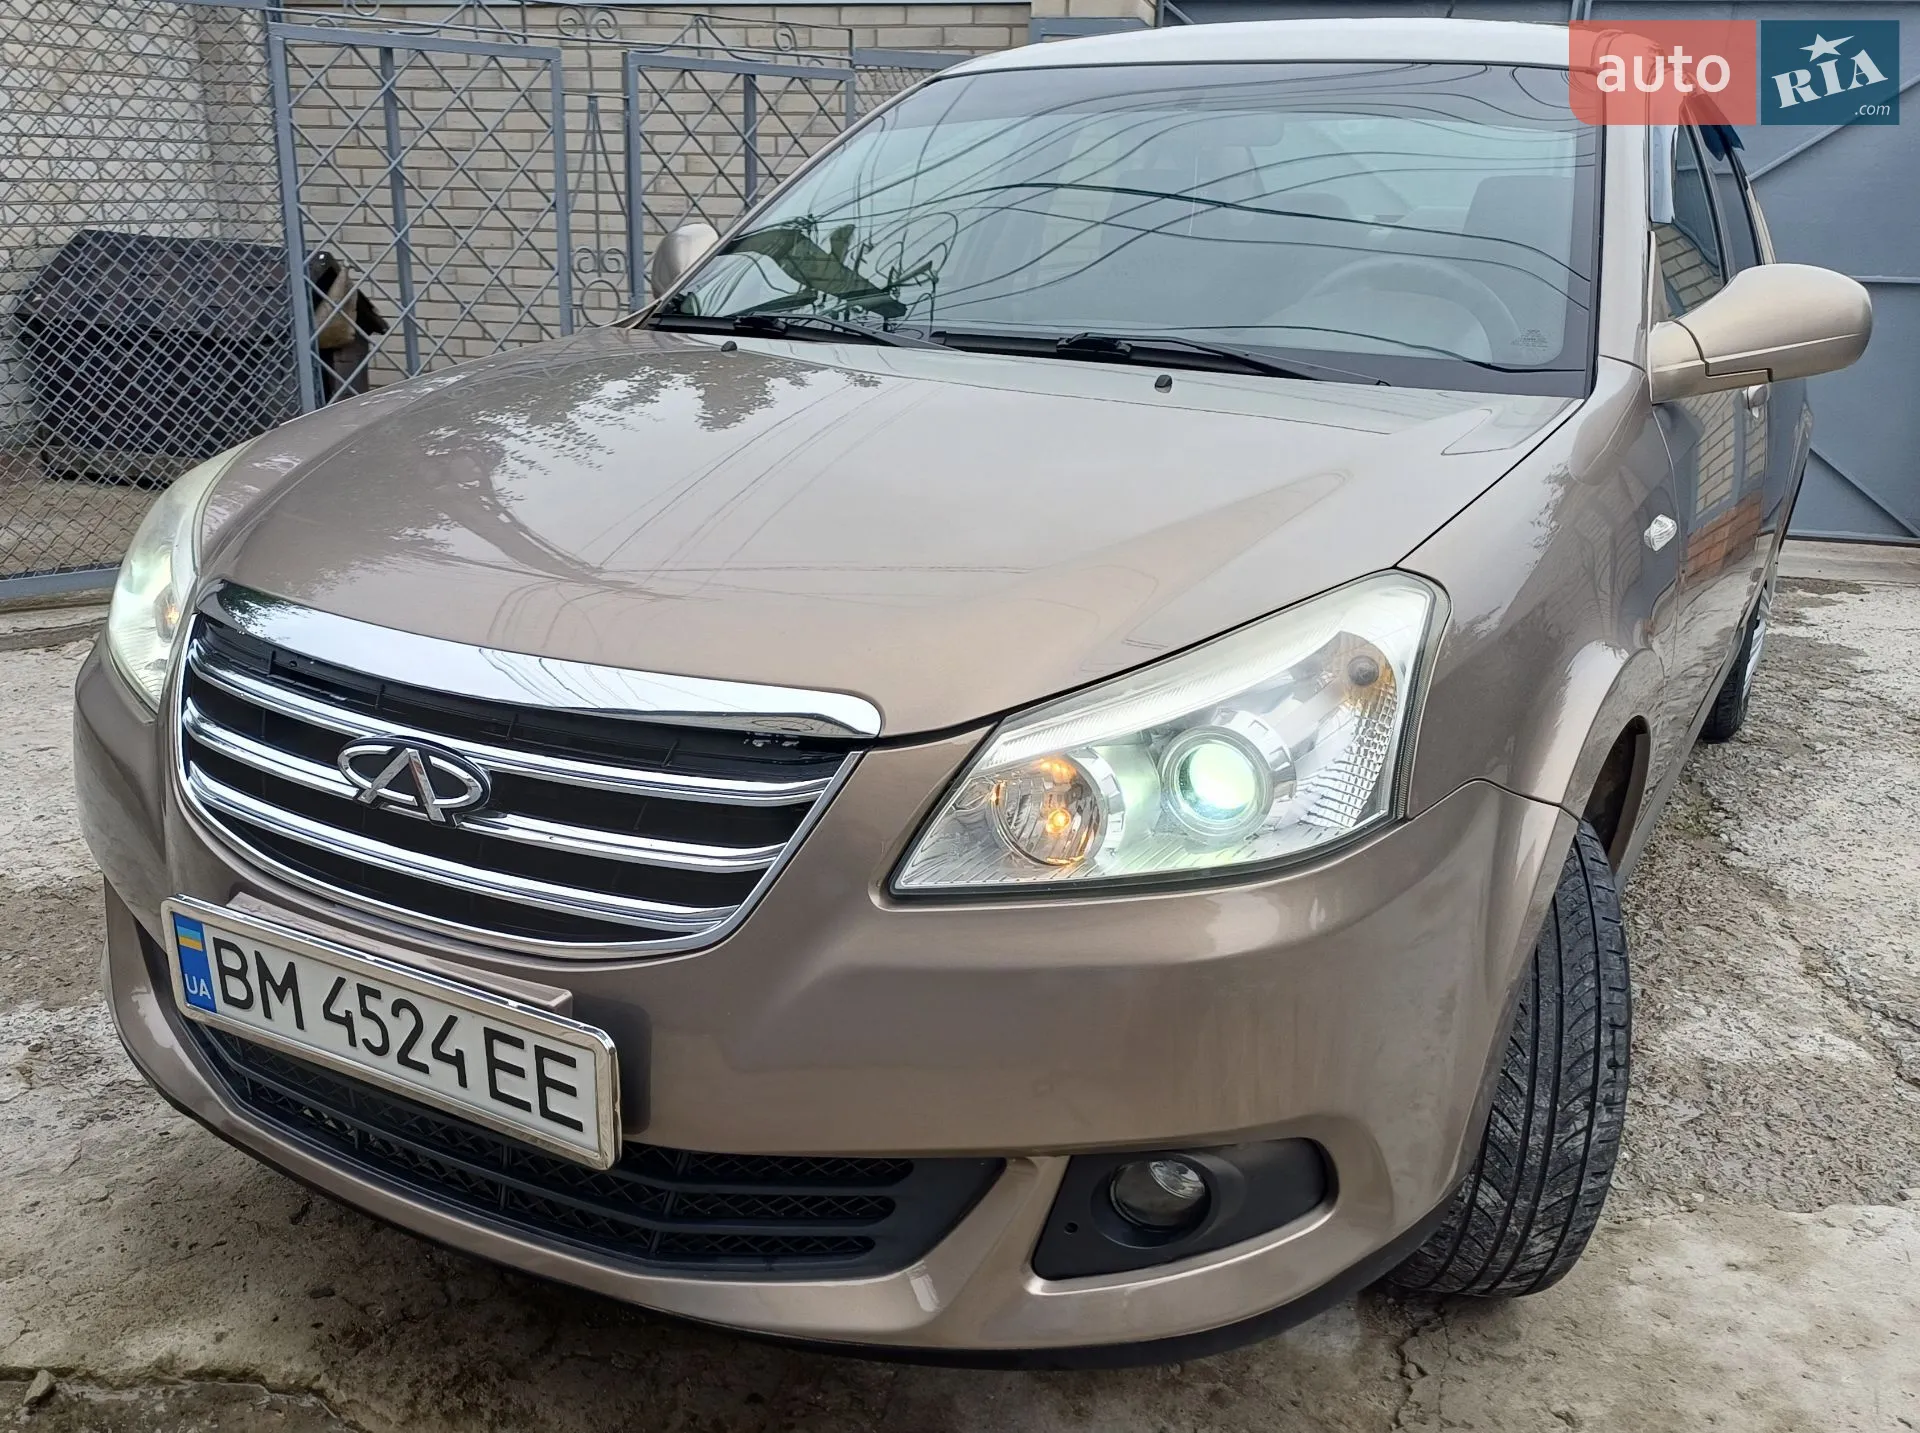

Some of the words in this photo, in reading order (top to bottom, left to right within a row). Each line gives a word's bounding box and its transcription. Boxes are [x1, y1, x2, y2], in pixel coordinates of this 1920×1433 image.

[185, 973, 212, 1000] UA
[213, 937, 304, 1030] BM
[323, 977, 467, 1088] 4524
[484, 1027, 583, 1132] EE
